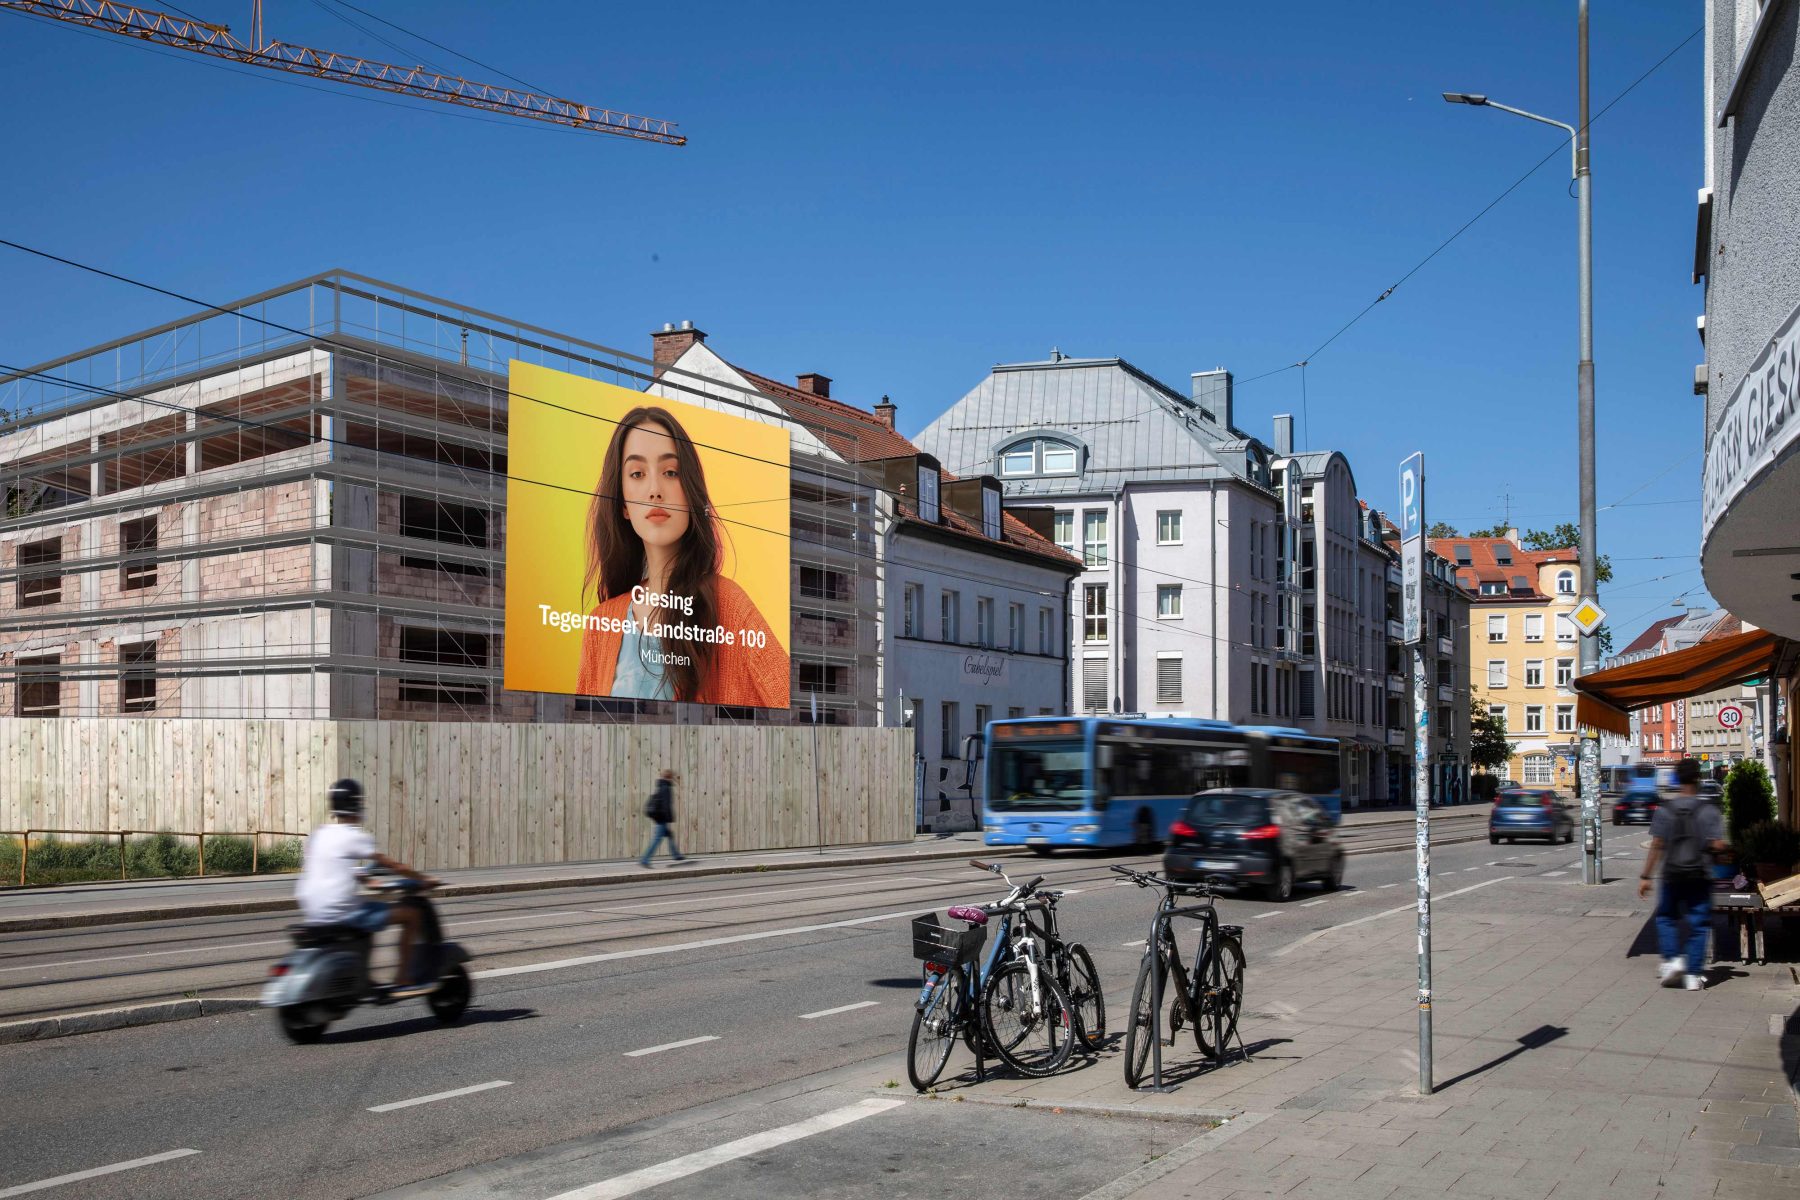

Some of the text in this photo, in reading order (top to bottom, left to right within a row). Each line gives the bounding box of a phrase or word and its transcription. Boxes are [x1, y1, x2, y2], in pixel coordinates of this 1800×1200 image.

[1748, 339, 1800, 457] GIESI
[1403, 468, 1415, 530] P
[631, 585, 694, 616] Giesing
[538, 604, 766, 649] Tegernseer Landstraße 100
[641, 648, 691, 667] München
[1723, 711, 1738, 723] 30
